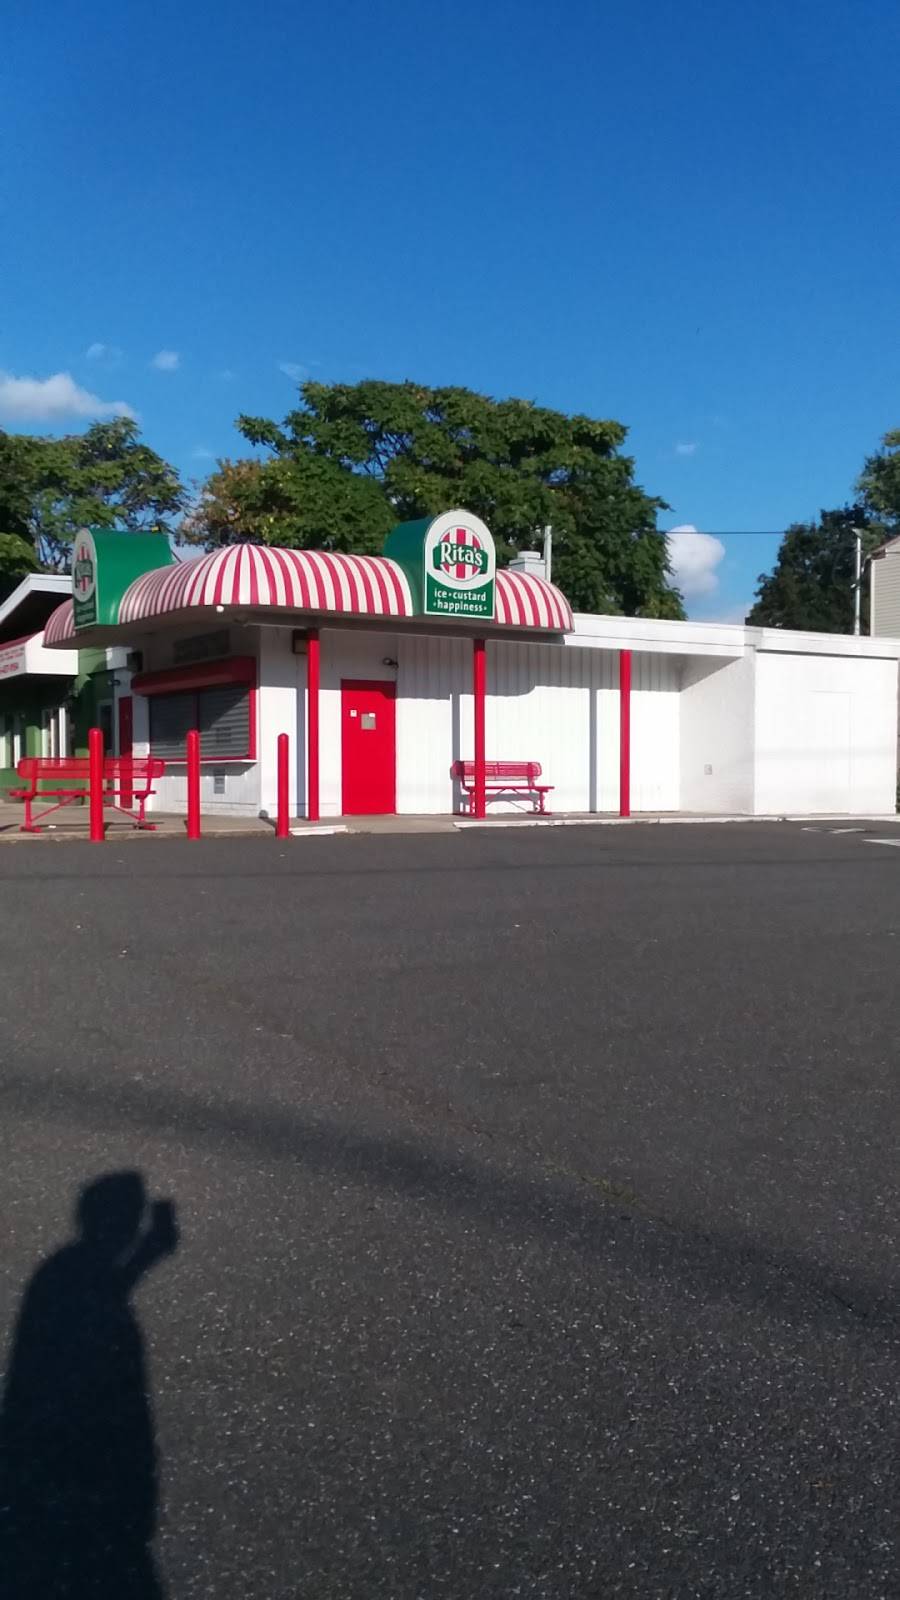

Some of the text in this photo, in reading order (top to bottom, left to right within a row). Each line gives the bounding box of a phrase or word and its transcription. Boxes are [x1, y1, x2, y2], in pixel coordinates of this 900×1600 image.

[440, 542, 483, 566] Rita's
[434, 588, 486, 601] ice custard
[437, 599, 483, 612] happiness
